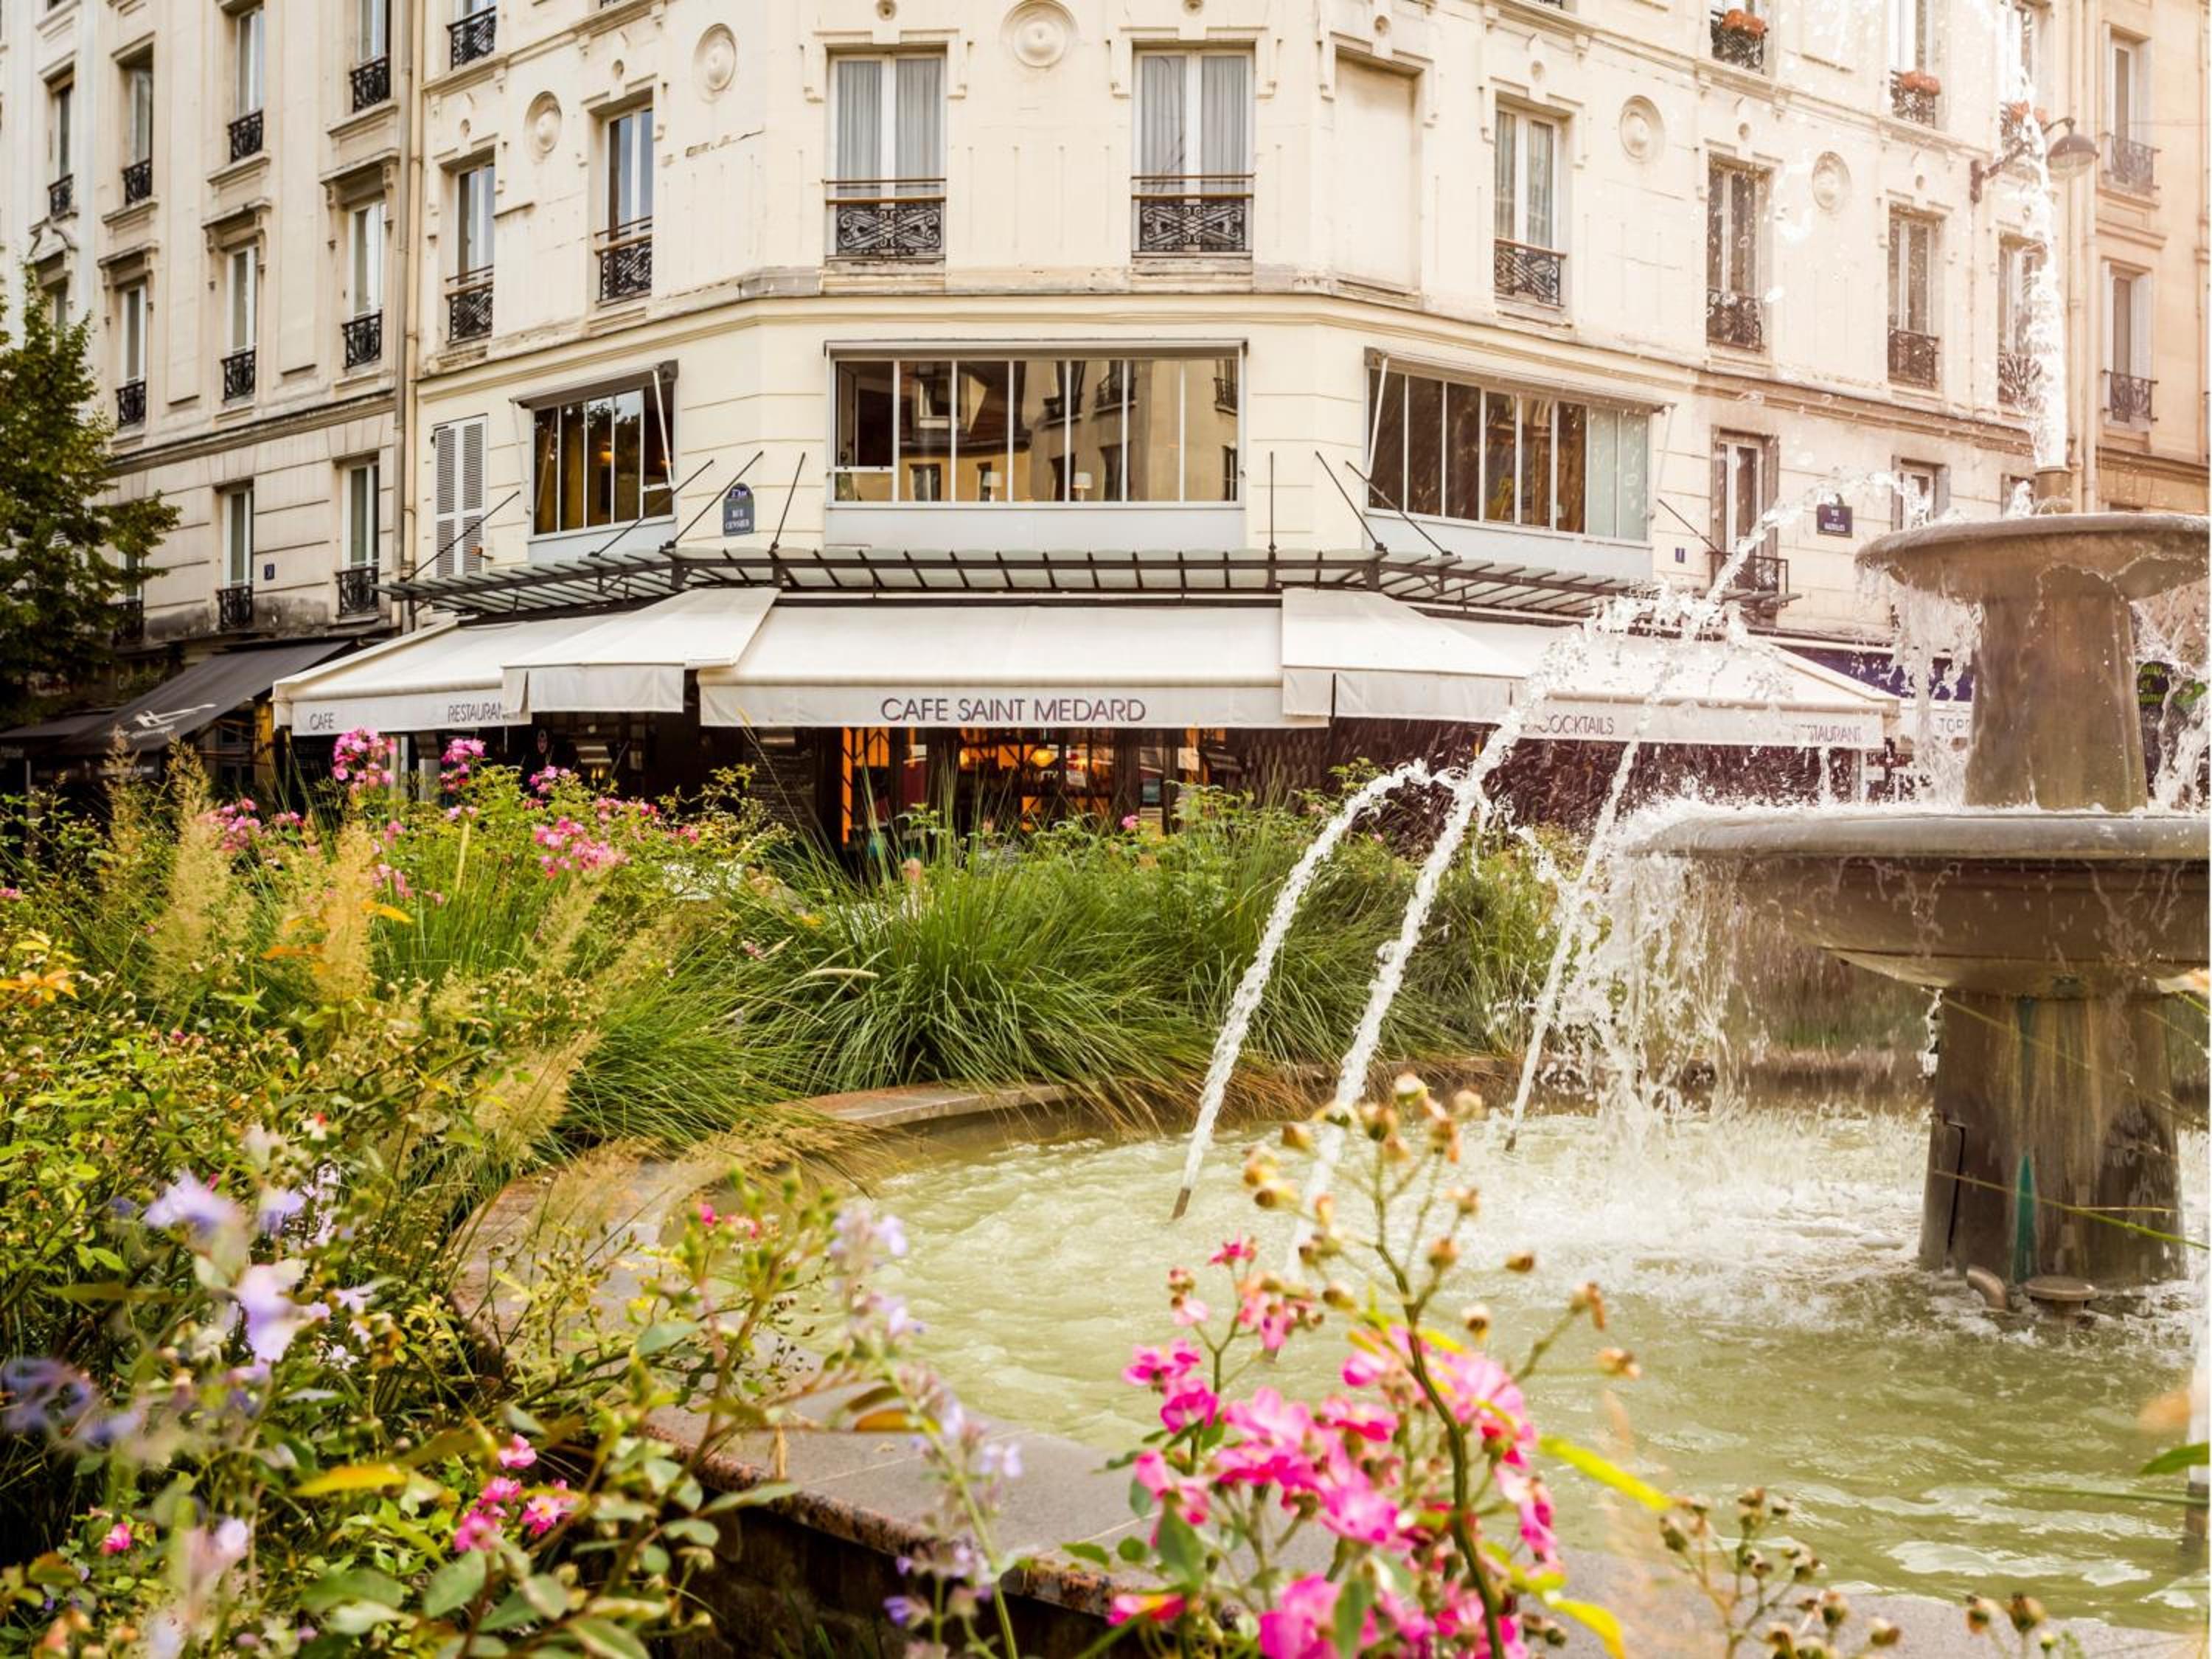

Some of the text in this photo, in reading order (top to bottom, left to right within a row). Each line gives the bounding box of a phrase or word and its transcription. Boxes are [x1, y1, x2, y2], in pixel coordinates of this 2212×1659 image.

[880, 698, 1144, 723] CAFE SAINT MEDARD
[309, 712, 335, 731] CAFE
[1798, 724, 1862, 743] STAURANT
